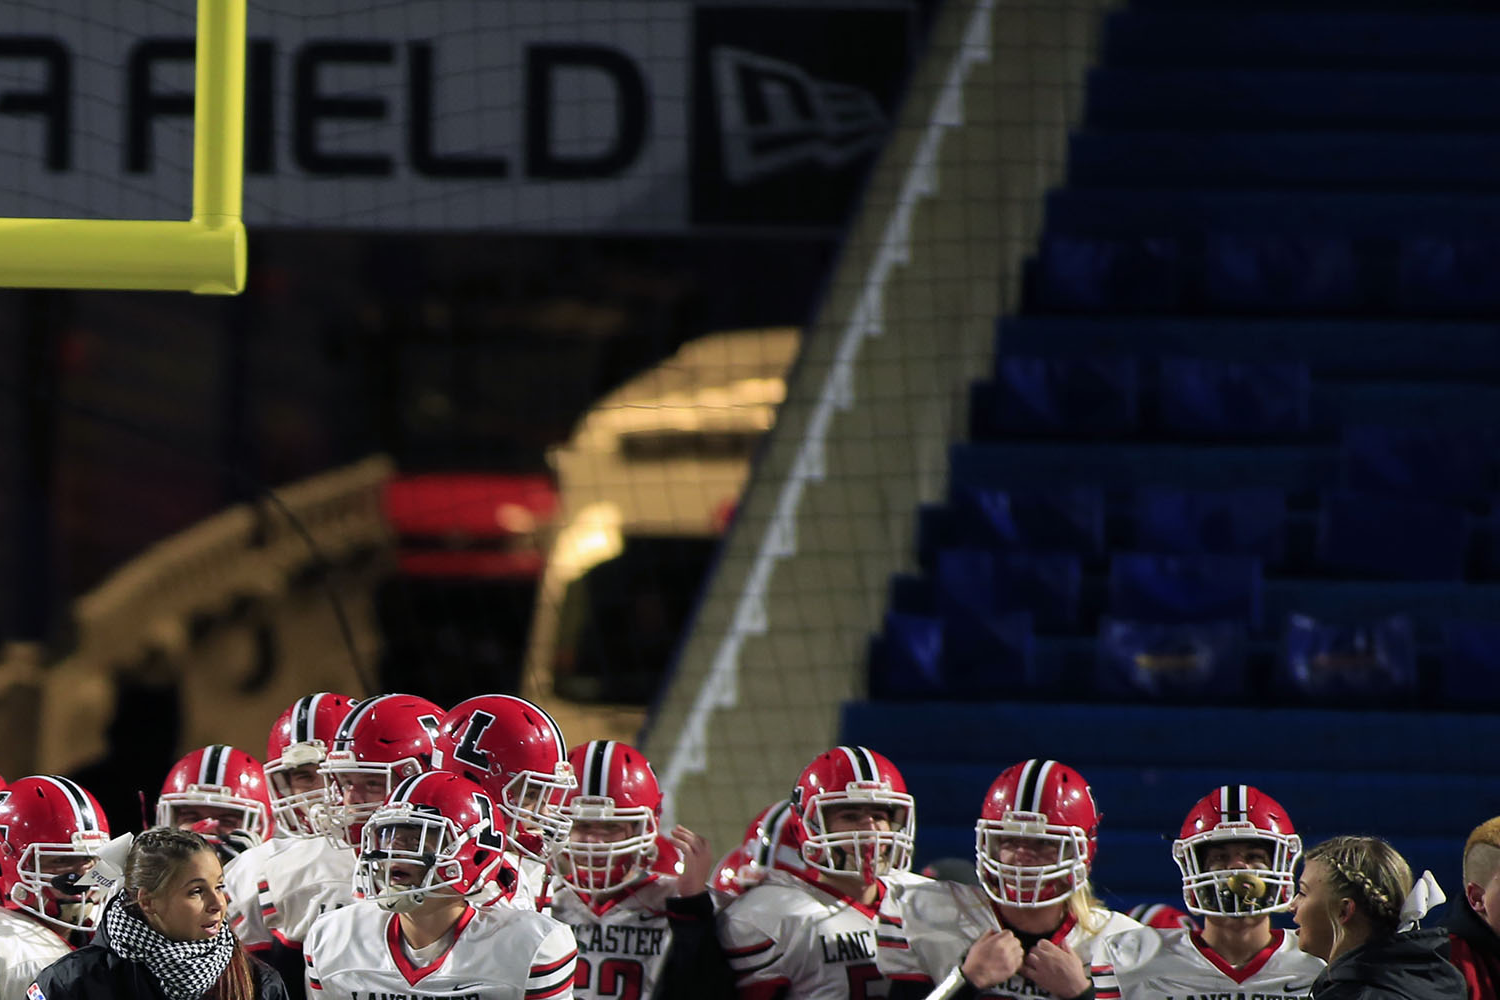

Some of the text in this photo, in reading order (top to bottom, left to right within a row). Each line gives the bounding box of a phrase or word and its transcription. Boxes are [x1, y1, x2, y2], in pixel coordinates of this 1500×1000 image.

[124, 36, 650, 179] FIELD
[453, 709, 496, 772] L
[572, 924, 664, 955] CASTER
